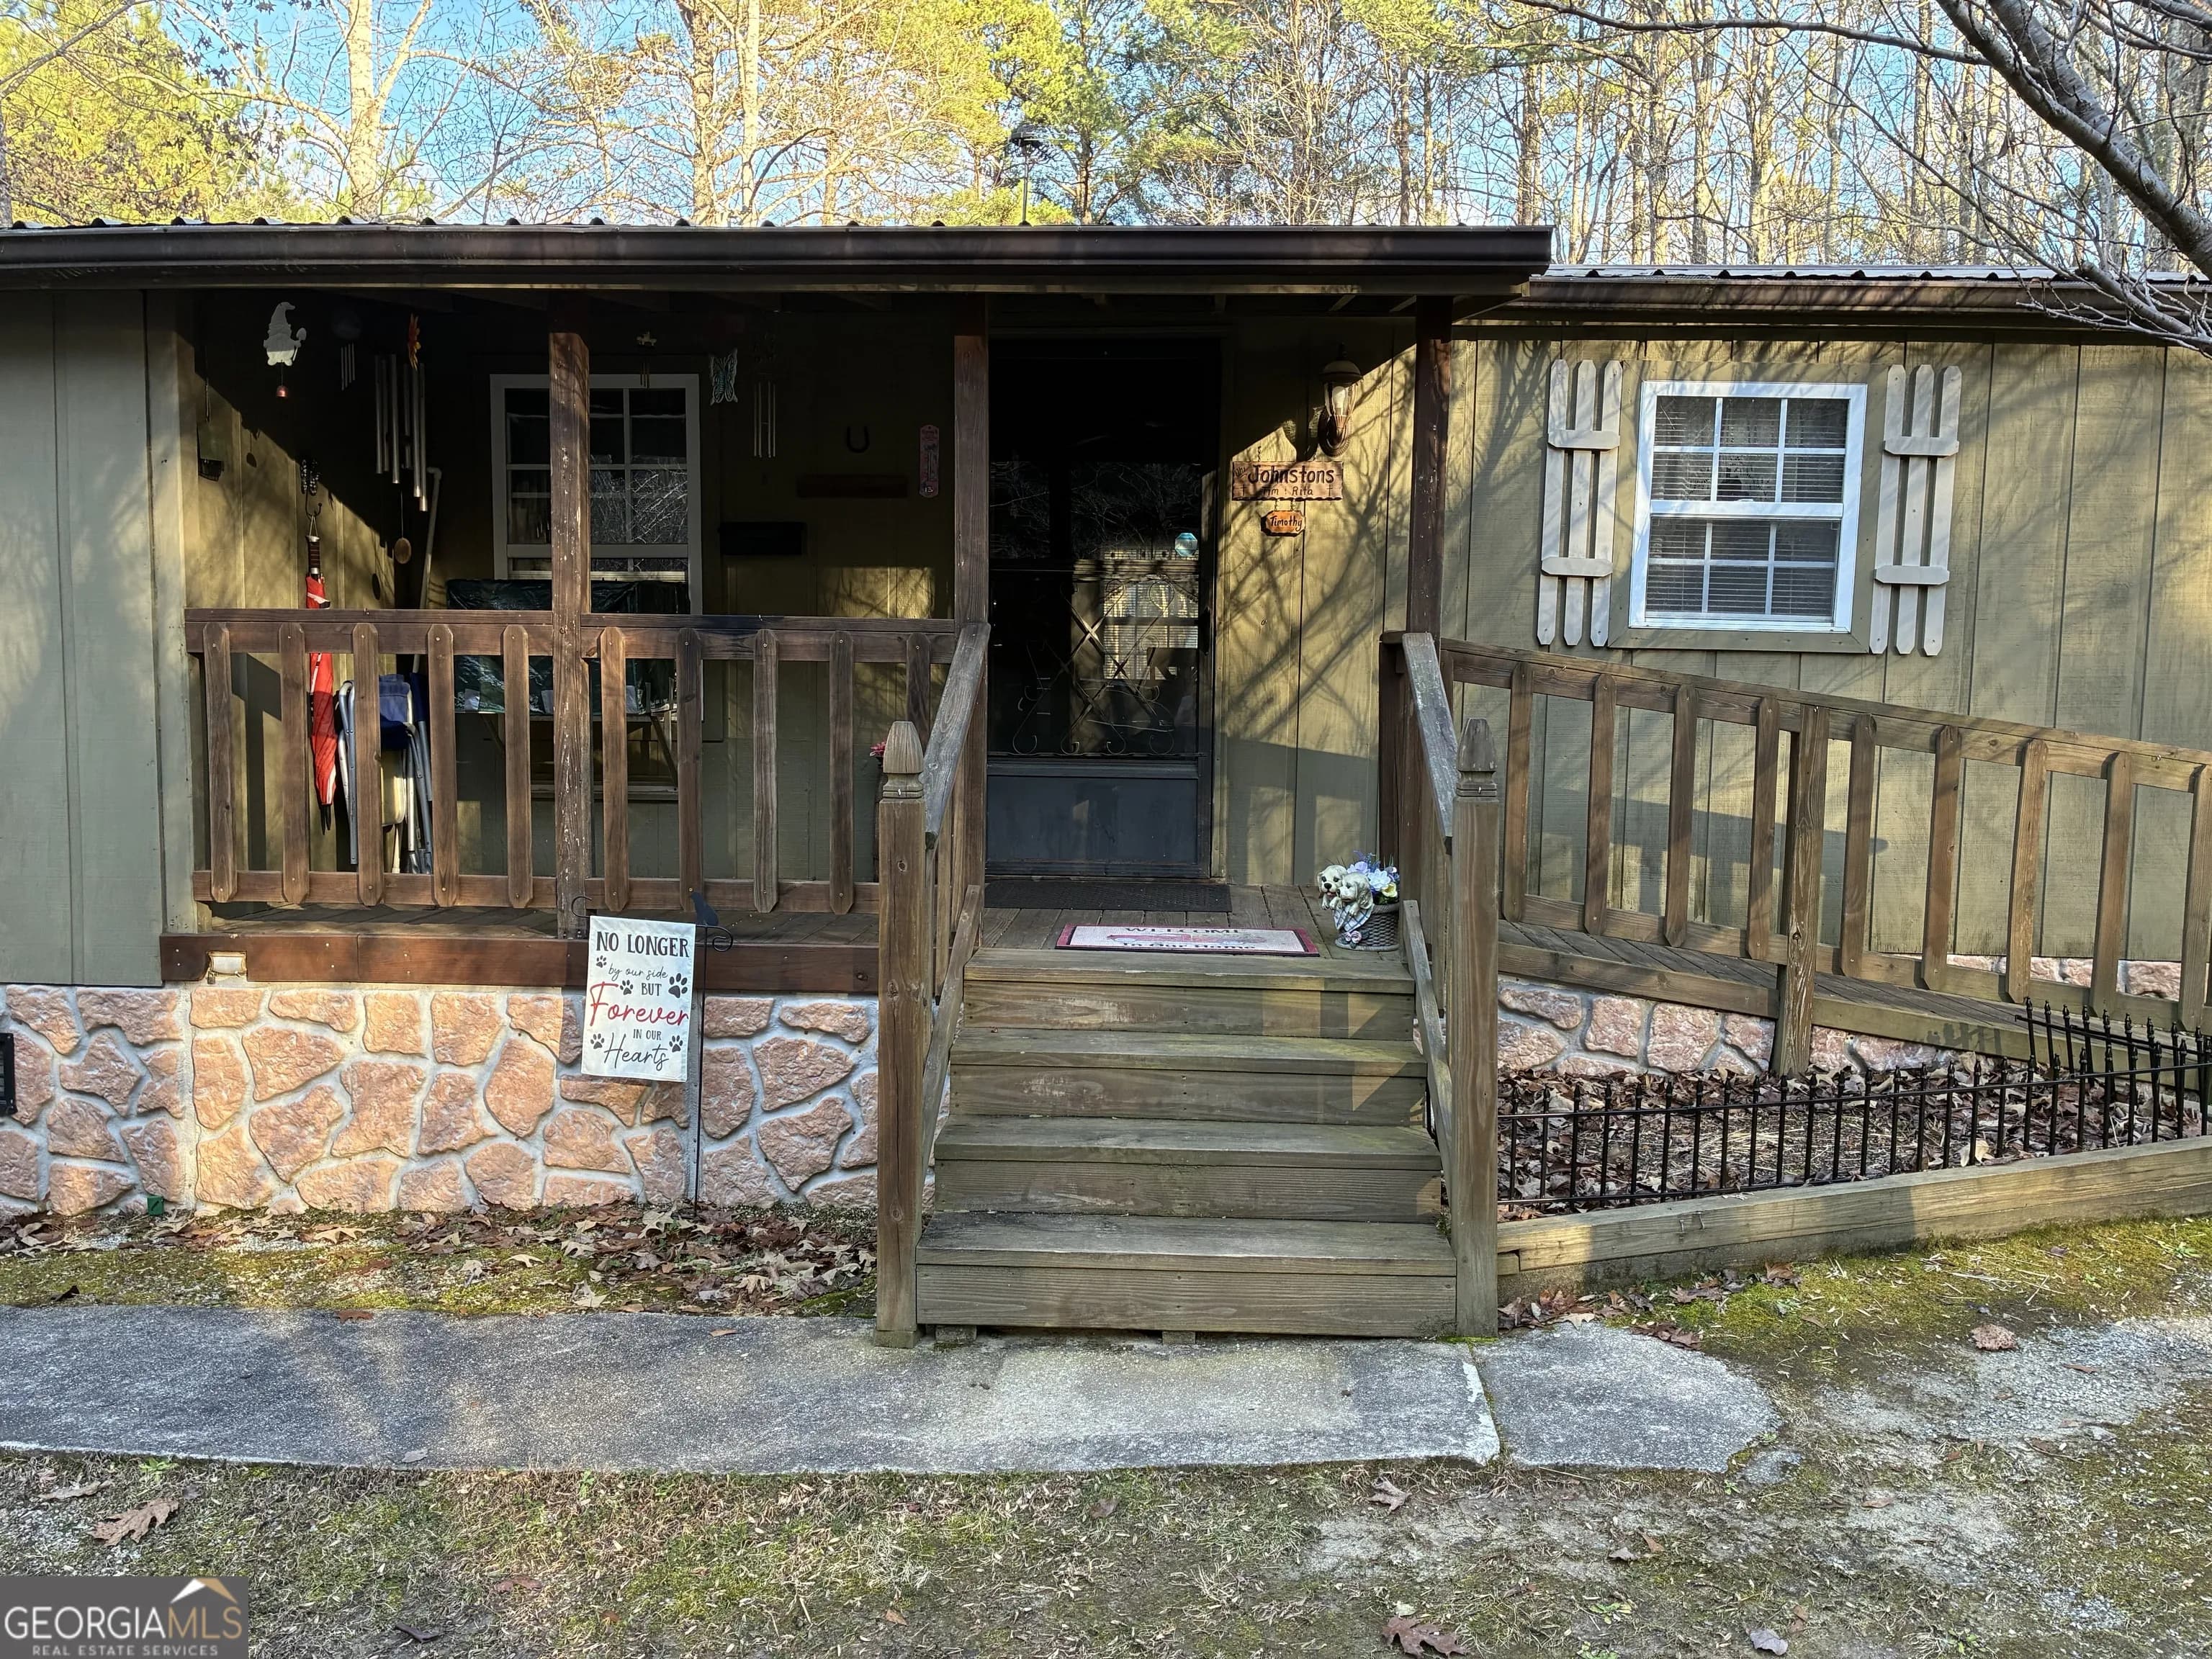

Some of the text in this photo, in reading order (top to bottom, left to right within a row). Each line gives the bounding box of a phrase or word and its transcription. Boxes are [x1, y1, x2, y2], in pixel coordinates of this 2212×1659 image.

[1248, 464, 1334, 484] Johnstons
[1262, 486, 1279, 496] Tim
[1292, 485, 1313, 496] Rita
[1270, 516, 1302, 531] Timothy
[596, 931, 689, 958] NO LONGER
[608, 963, 668, 981] by our side
[641, 982, 662, 997] BUT
[590, 981, 688, 1027] Forever
[633, 1028, 662, 1040] IN OUR
[603, 1032, 670, 1071] Hearts
